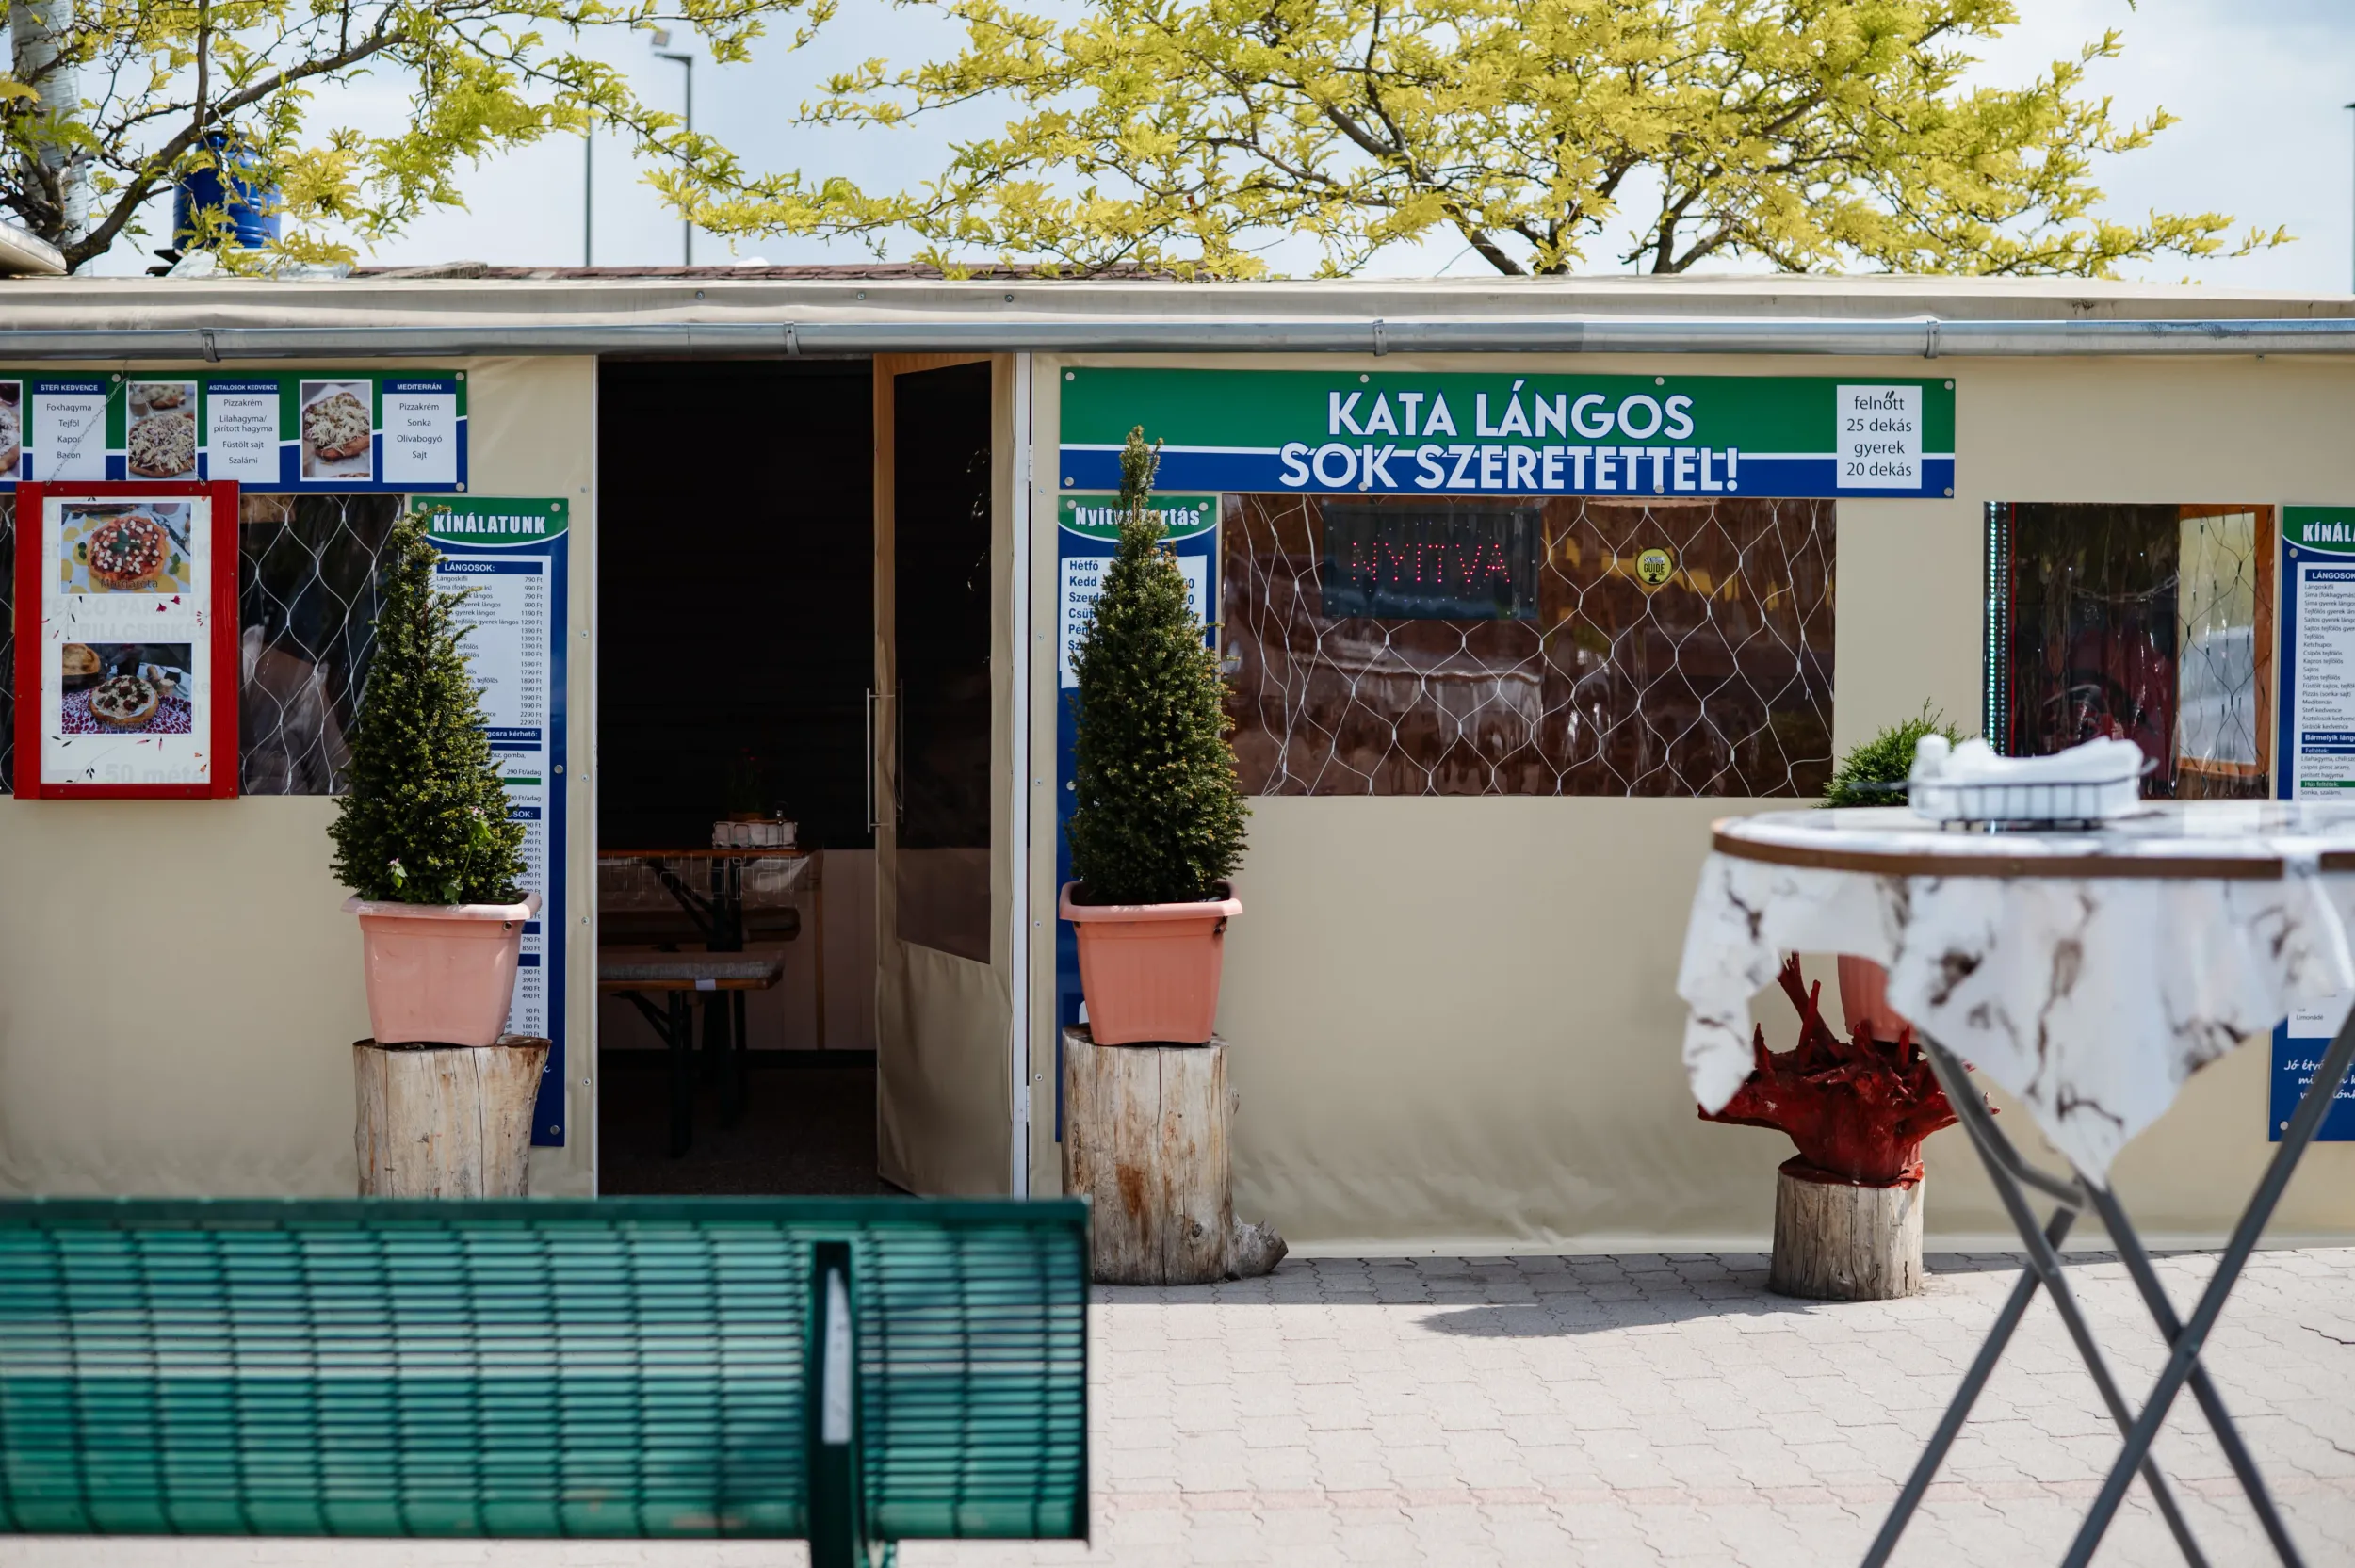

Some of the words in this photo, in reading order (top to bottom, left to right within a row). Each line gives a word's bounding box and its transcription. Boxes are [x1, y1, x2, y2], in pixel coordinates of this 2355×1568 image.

[397, 382, 442, 390] MEDITERRÁN
[1854, 391, 1905, 410] felnőtt
[47, 403, 92, 413] Fokhagyma
[1328, 390, 1458, 437] KATA
[1474, 379, 1696, 440] LÁNGOS
[59, 419, 80, 428] Tejföl
[219, 415, 267, 424] Lilahagyma/
[213, 425, 240, 434] pirított
[242, 425, 273, 434] hagyma
[1847, 418, 1864, 432] 25
[1869, 418, 1912, 432] dekás
[57, 435, 81, 444] Kapor
[250, 441, 264, 449] sajt
[1854, 440, 1905, 457] gyerek
[412, 451, 427, 460] Sajt
[1278, 442, 1398, 489] SOK
[1414, 444, 1739, 492] SZERETETTEL!
[1847, 462, 1865, 476] 20
[1869, 462, 1912, 476] dekás
[433, 512, 546, 533] KÍNÁLATUNK
[2303, 521, 2355, 542] KÍNÁL
[444, 562, 495, 571] LÁNGOSOK:
[1070, 560, 1099, 571] Hétfő
[1352, 542, 1510, 582] NYITVA
[1644, 564, 1665, 572] GUIDE
[1070, 576, 1097, 586] Kedd
[2305, 734, 2338, 742] Bármelyik
[2284, 1060, 2300, 1070] Jó
